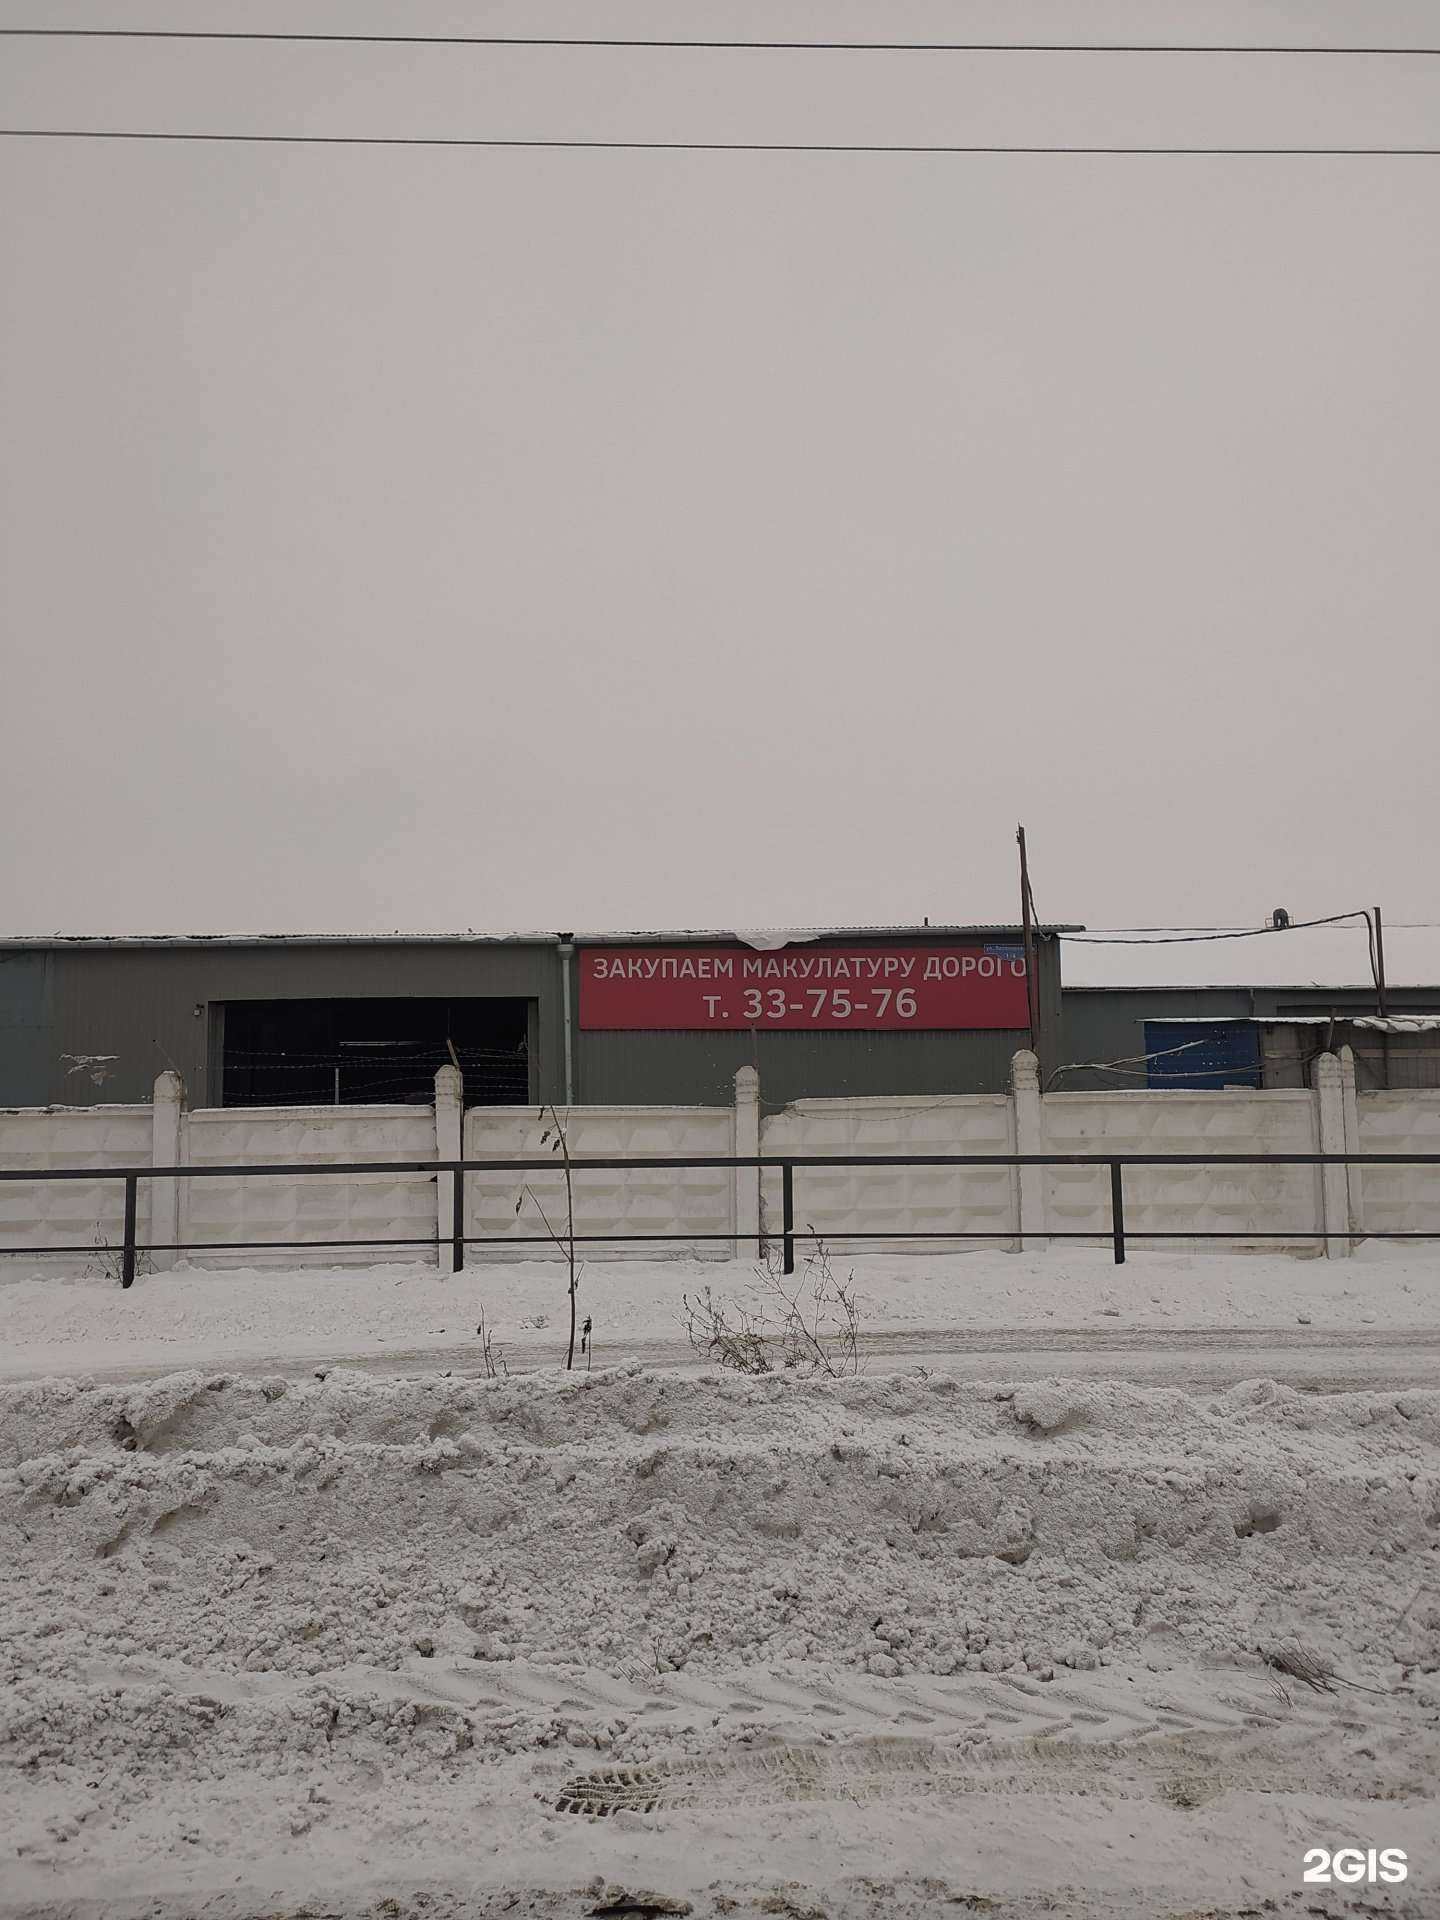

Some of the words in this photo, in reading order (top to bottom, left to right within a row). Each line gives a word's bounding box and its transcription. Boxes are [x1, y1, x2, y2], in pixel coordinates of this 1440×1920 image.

[593, 958, 733, 979] ЗАКУПАЕМ
[743, 957, 916, 978] МАКУЛАТУРУ
[743, 988, 918, 1018] 33-75-76
